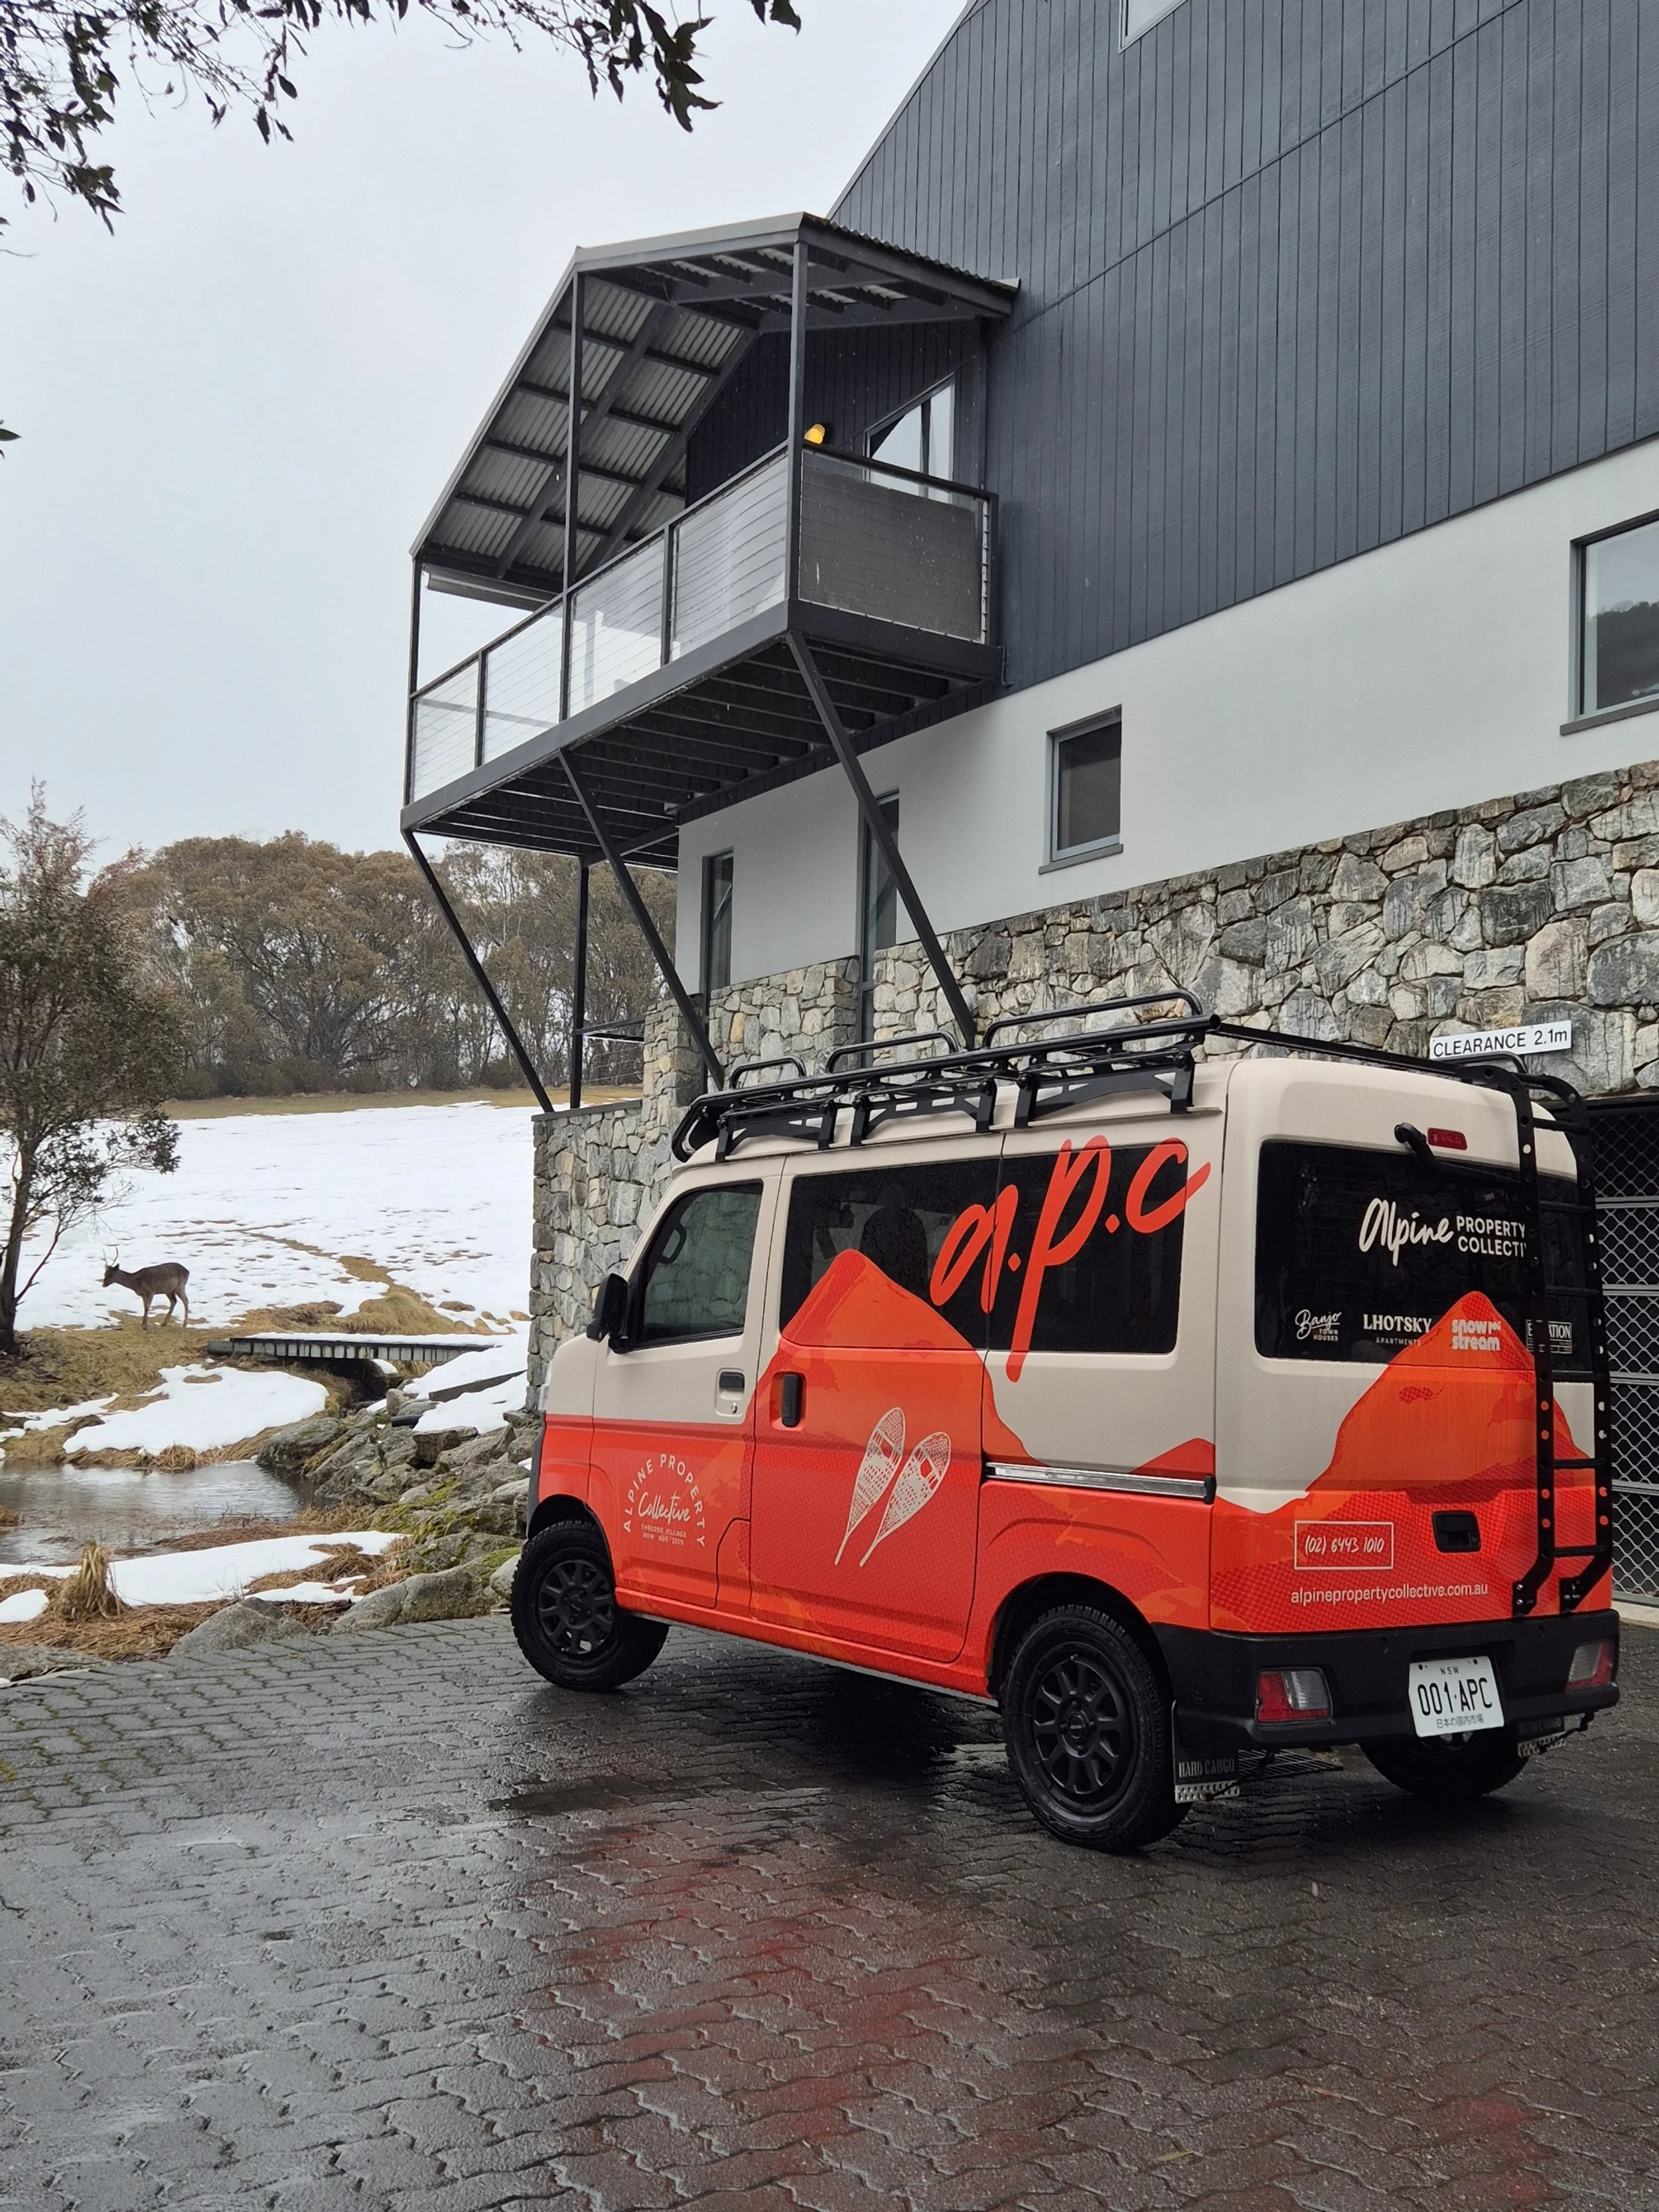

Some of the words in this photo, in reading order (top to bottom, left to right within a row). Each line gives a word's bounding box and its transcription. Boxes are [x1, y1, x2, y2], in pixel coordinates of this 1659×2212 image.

[1433, 1031, 1526, 1057] CLEARANCE
[1534, 1028, 1567, 1045] 2.1m
[1359, 1197, 1455, 1267] Alpine
[1456, 1215, 1526, 1238] PROPERTY
[1458, 1236, 1527, 1258] COLLECTI
[1295, 1309, 1342, 1340] Banjo
[1363, 1313, 1433, 1333] LHOTSKY
[1375, 1337, 1421, 1346] APARTMENTS
[1451, 1334, 1500, 1351] stream
[624, 1459, 654, 1533] ALPINE
[660, 1453, 705, 1547] PROPERTY
[638, 1491, 691, 1525] Collective
[1305, 1535, 1327, 1556] (02)
[1331, 1536, 1359, 1554] 6443
[1363, 1536, 1385, 1554] 1010
[1291, 1583, 1488, 1607] alpinepropertycollective.com.au
[1440, 1666, 1460, 1676] NSW
[1179, 1761, 1202, 1778] HARD
[1204, 1758, 1235, 1775] CARGO
